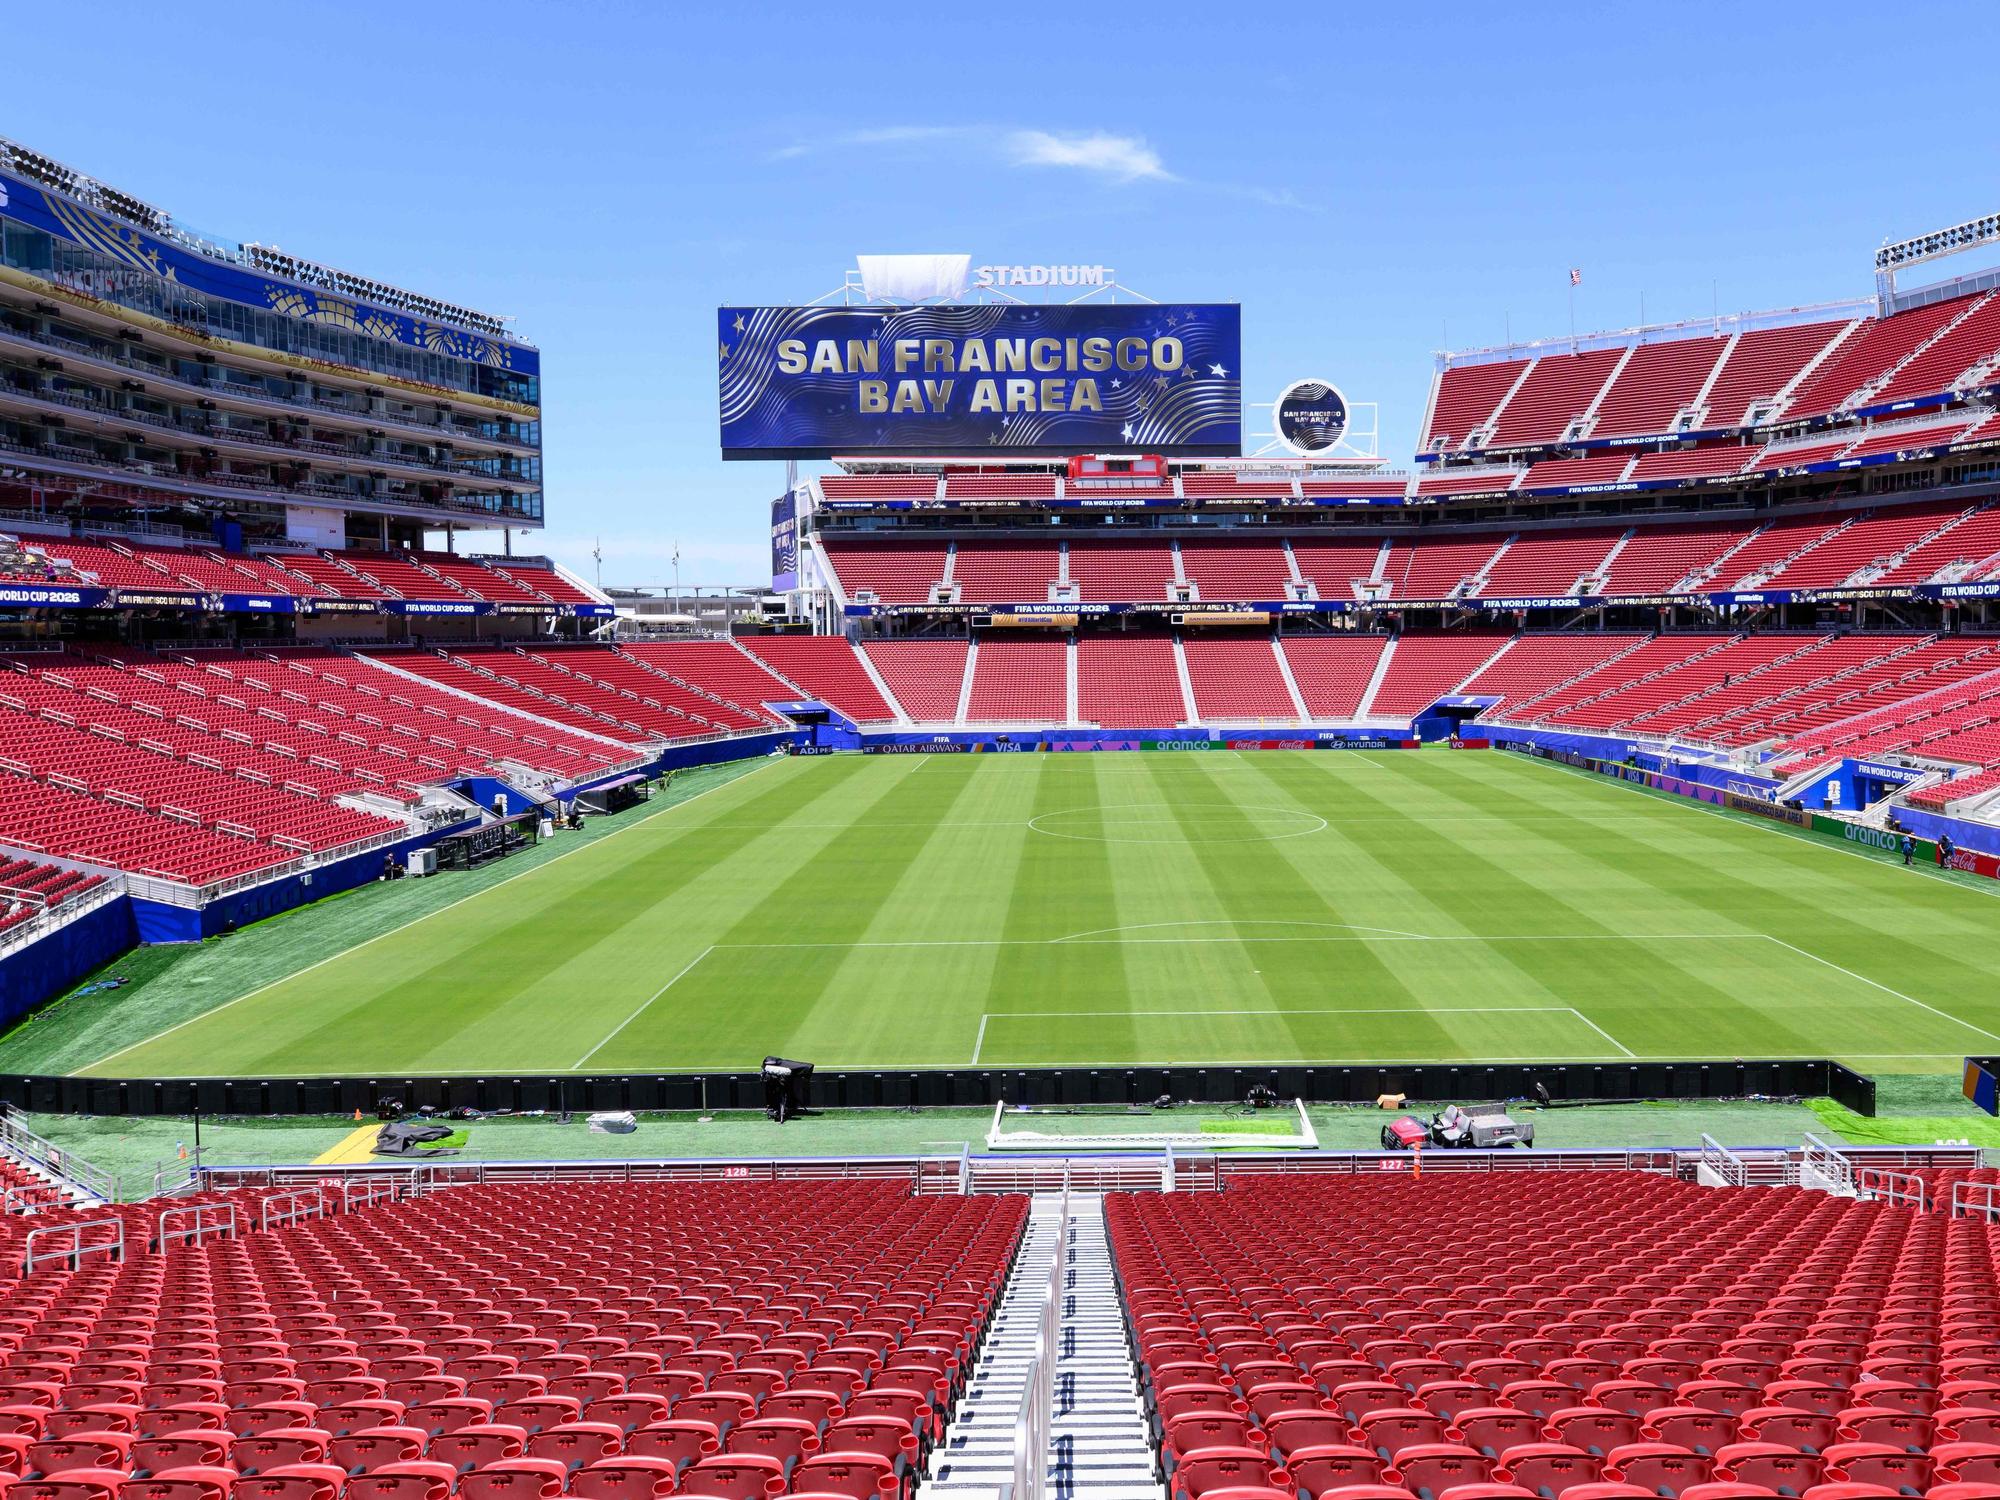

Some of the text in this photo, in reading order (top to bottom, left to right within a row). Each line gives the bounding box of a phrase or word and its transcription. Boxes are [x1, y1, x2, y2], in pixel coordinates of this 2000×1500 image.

[977, 265, 1102, 286] STADIUM
[777, 336, 1184, 374] SAN FRANCISCO
[859, 378, 1103, 413] BAY AREA
[1623, 437, 1644, 445] WORLD
[1644, 436, 1657, 444] CUP
[1657, 435, 1679, 443] 2026
[1582, 485, 1603, 493] WORLD
[1817, 589, 1912, 599] SAN FRANCISCO BAY AREA
[1942, 585, 2000, 596] FIFA WORLD CUP
[30, 591, 49, 602] CUP
[49, 591, 80, 603] 2026
[118, 595, 133, 604] SAN
[133, 595, 168, 605] FRANCISCO
[181, 597, 196, 606] AREA
[1608, 597, 1624, 605] SAN
[1624, 597, 1662, 605] FRANCISCO
[358, 603, 375, 611] AREA
[1501, 599, 1531, 607] WORLD
[1532, 599, 1549, 607] CUP
[1550, 599, 1580, 607] 2026
[405, 604, 475, 613] FIFA WORLD CUP 2026
[1015, 605, 1032, 613] FIFA
[1033, 605, 1062, 613] WORLD
[883, 743, 961, 754] QATAR AIRWAYS
[997, 743, 1021, 752] VISA
[1157, 740, 1210, 751] aramco
[1235, 741, 1262, 750] Coca-Cola
[1279, 741, 1304, 750] Coca-Cola
[1603, 764, 1615, 777] VISA
[1627, 768, 1640, 783] VISA
[1859, 765, 1870, 774] FIFA
[1871, 767, 1890, 777] WORLD
[1892, 770, 1903, 780] CUP
[1844, 823, 1896, 850] aramco
[1381, 1160, 1402, 1170] 127
[726, 1168, 747, 1177] 128
[320, 1179, 341, 1187] 129
